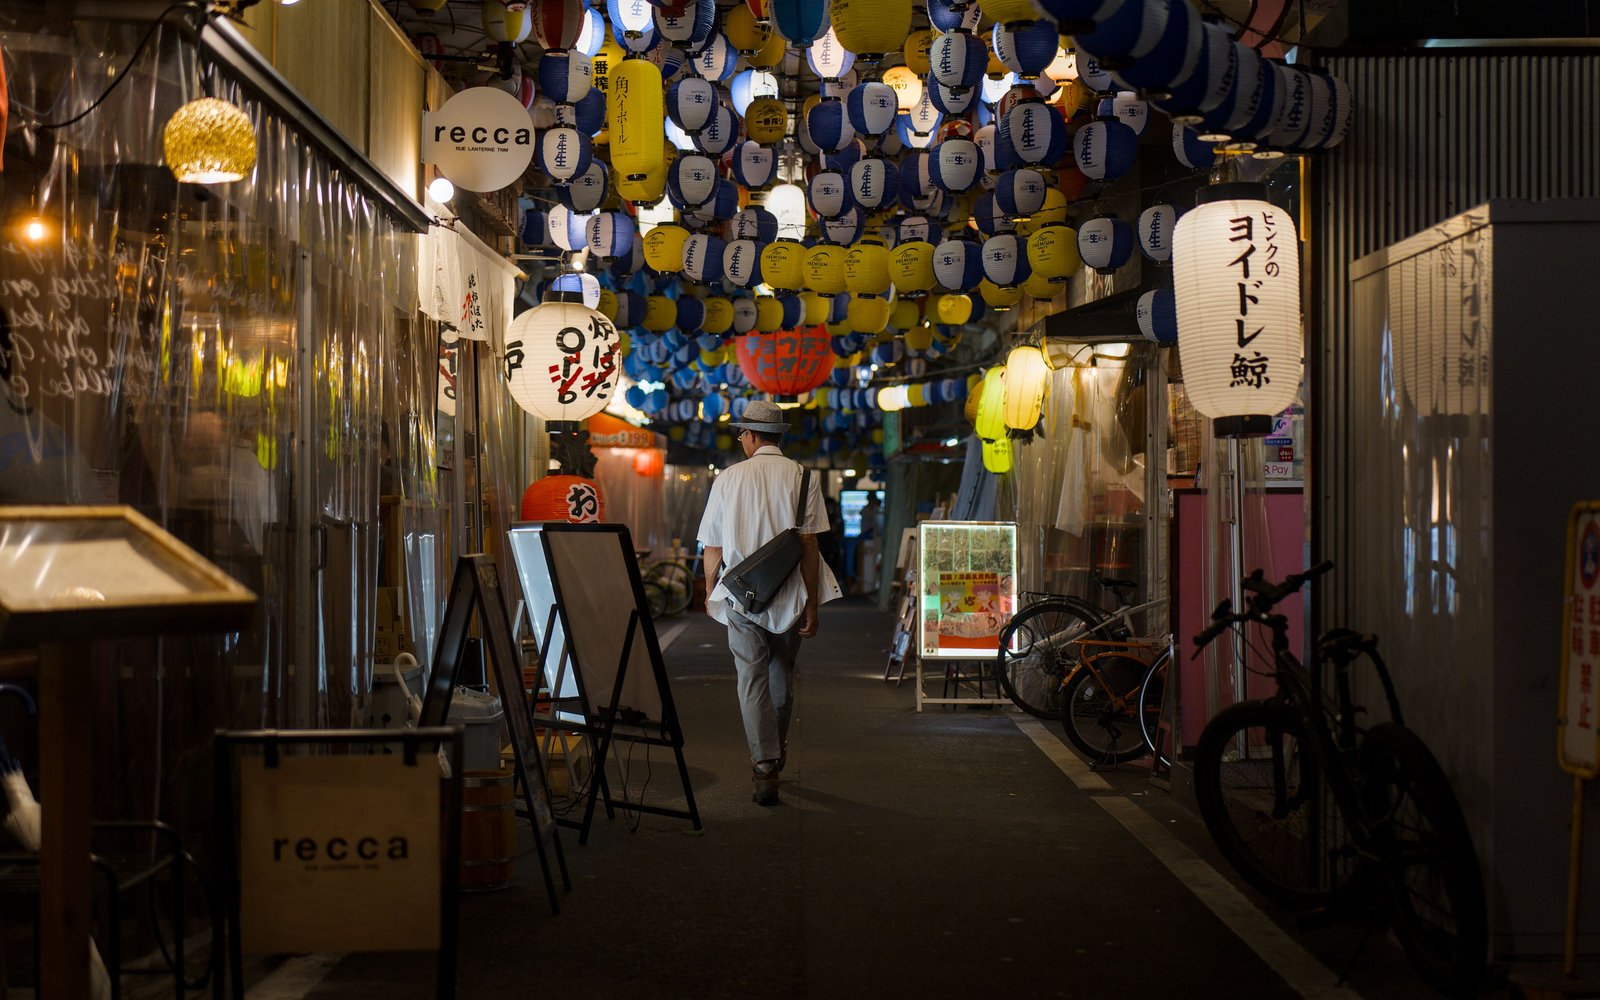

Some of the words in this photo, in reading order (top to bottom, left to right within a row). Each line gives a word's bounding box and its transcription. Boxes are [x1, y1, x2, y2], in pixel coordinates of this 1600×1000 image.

[615, 76, 629, 144] 角ハイボール
[435, 126, 530, 145] recca
[555, 134, 567, 166] 生生生
[860, 164, 872, 196] 生生生
[1149, 211, 1162, 248] 生生生
[1227, 216, 1270, 389] ヨイドレ鯨
[1272, 466, 1288, 475] Pay
[568, 486, 597, 522] お
[273, 836, 408, 861] recca
